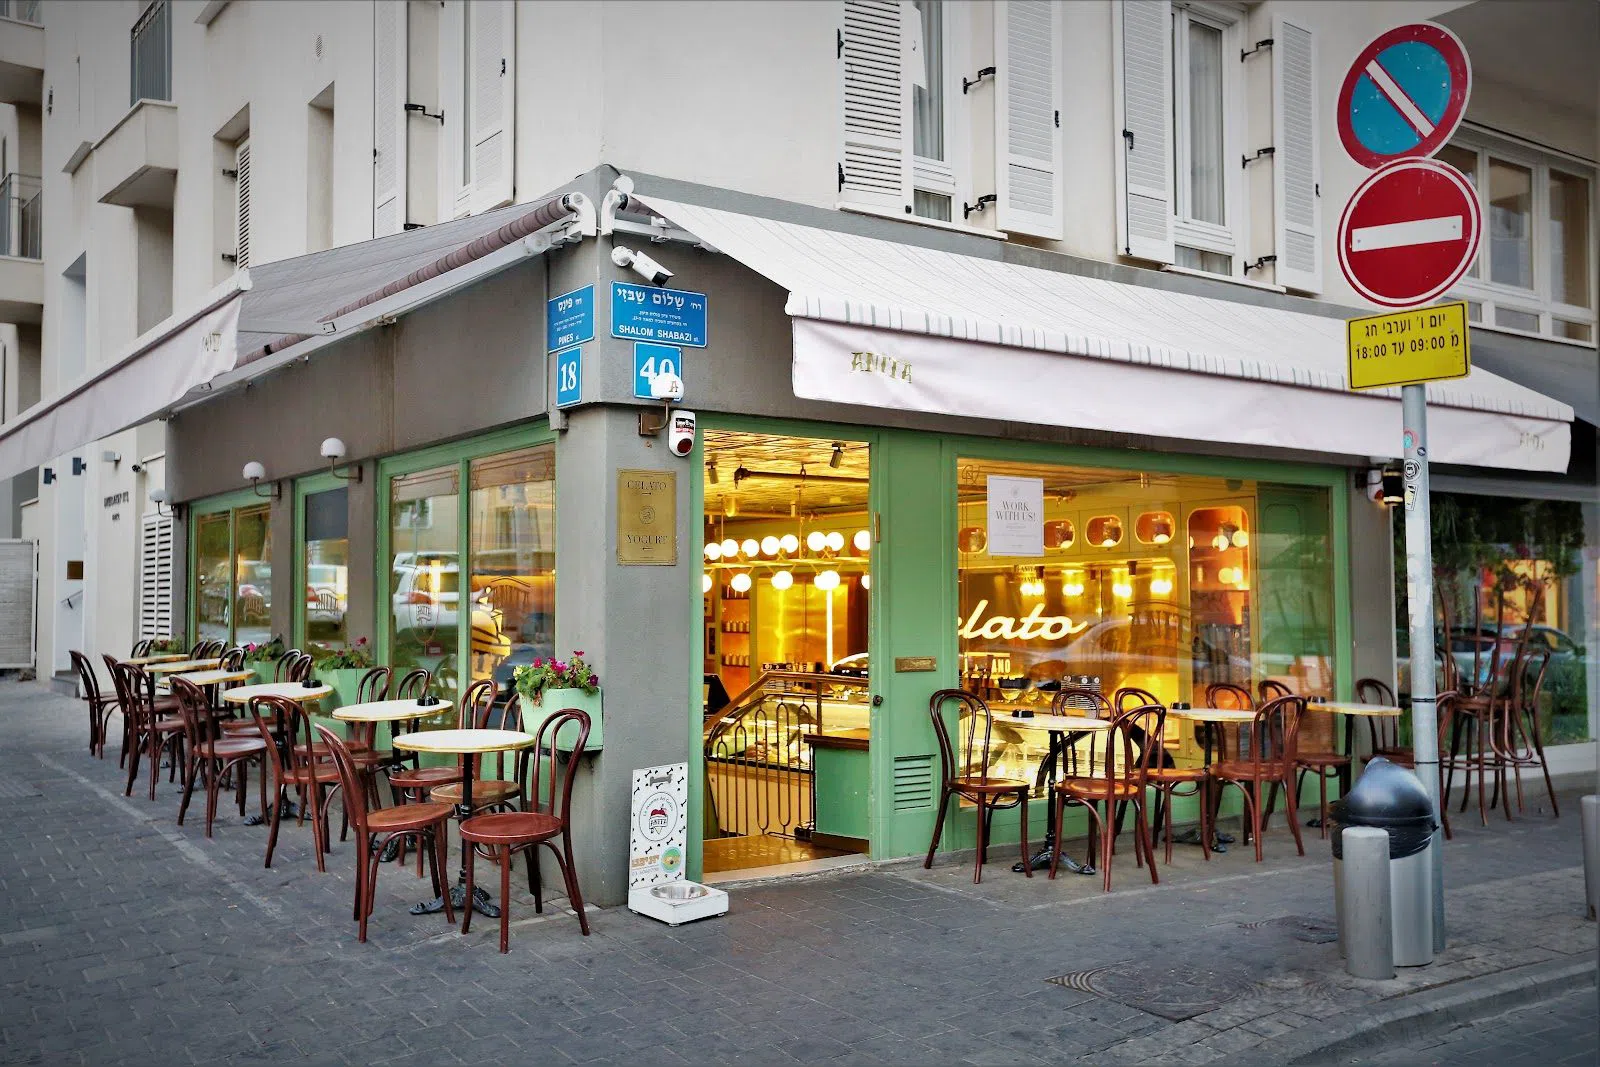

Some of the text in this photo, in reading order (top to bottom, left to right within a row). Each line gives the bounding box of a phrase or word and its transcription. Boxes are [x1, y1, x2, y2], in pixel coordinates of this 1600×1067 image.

[619, 324, 654, 337] SHALOM
[657, 329, 692, 342] SHABAZI
[1365, 324, 1378, 337] חג
[1382, 319, 1411, 334] וערבי
[558, 332, 574, 345] PINES
[1410, 335, 1445, 353] 09:00
[1355, 343, 1387, 360] 18:00
[1391, 341, 1405, 356] עד
[560, 360, 577, 393] 18
[627, 480, 667, 491] GELATO
[1001, 500, 1030, 511] WORK
[996, 510, 1020, 521] WITH
[627, 534, 668, 545] YOGURT
